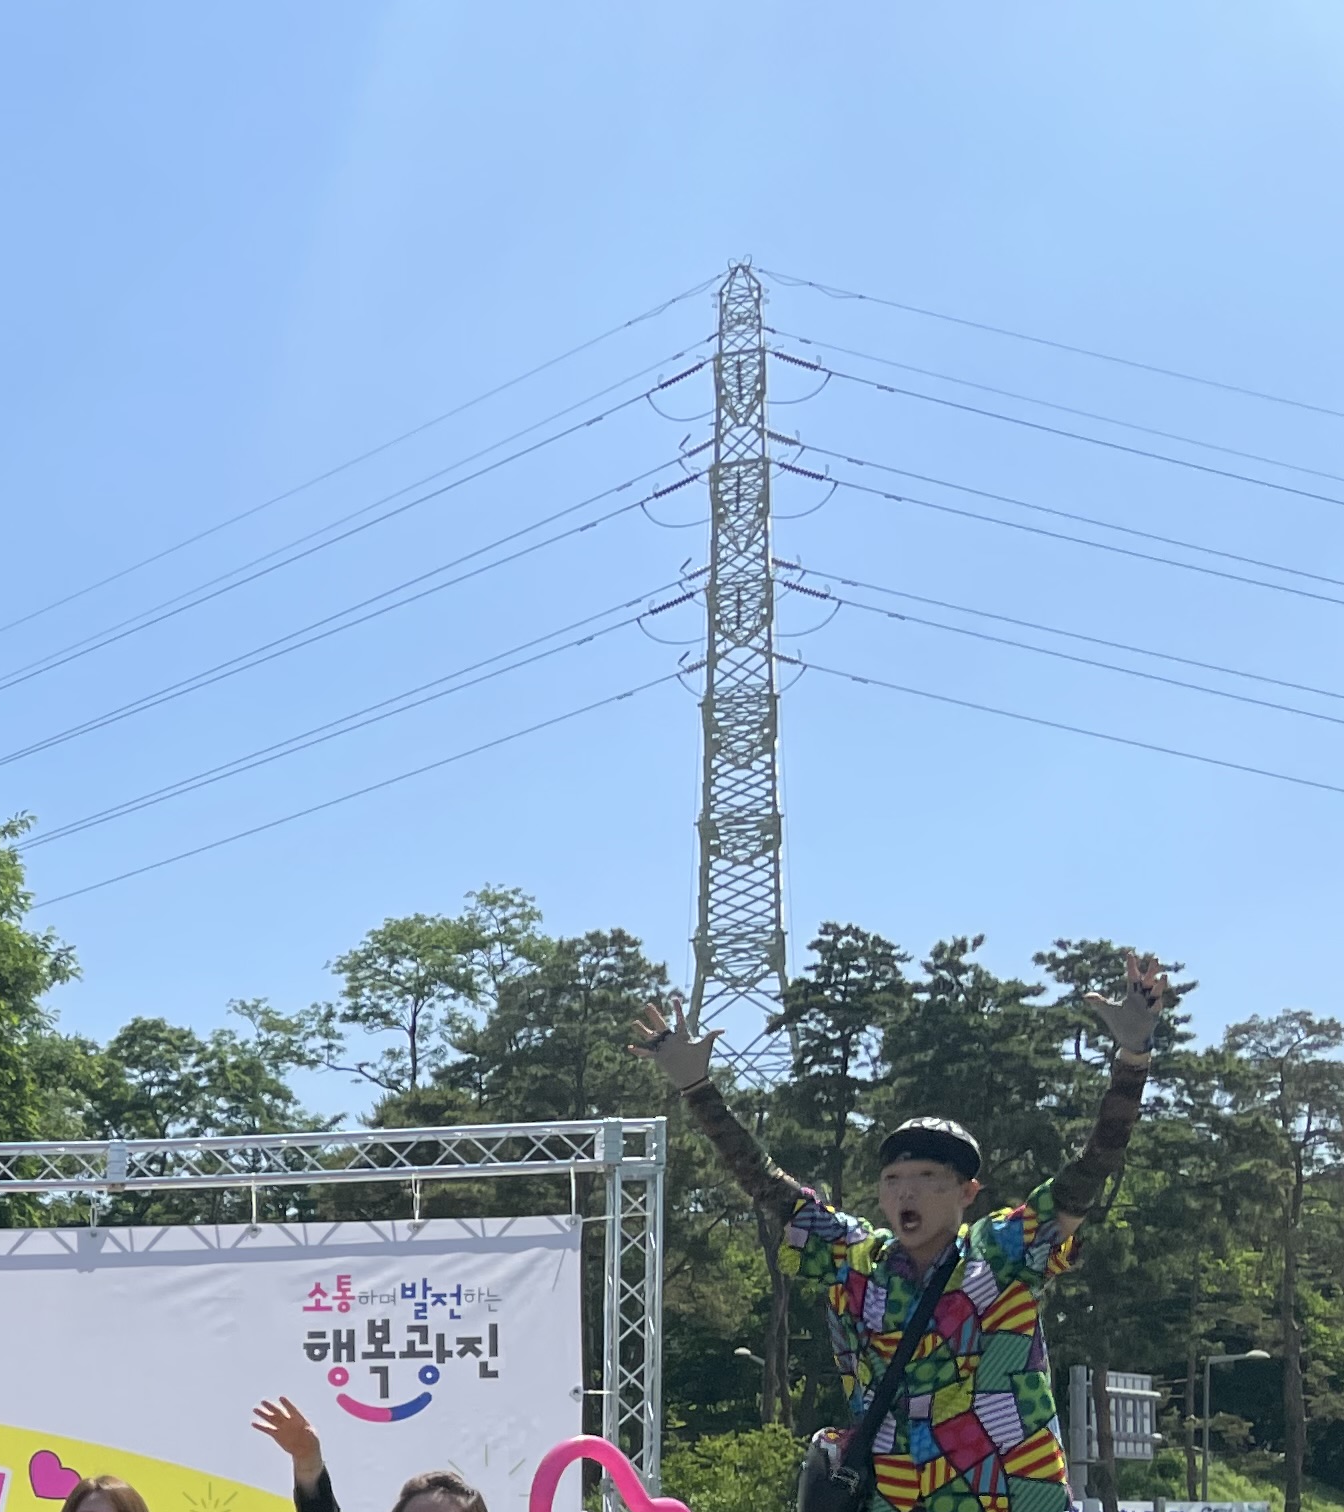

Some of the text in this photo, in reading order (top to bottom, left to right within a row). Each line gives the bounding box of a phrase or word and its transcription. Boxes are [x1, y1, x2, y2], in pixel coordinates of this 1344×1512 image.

[302, 1274, 503, 1320] 소통하며 발전하는
[302, 1318, 499, 1399] 행복광진
